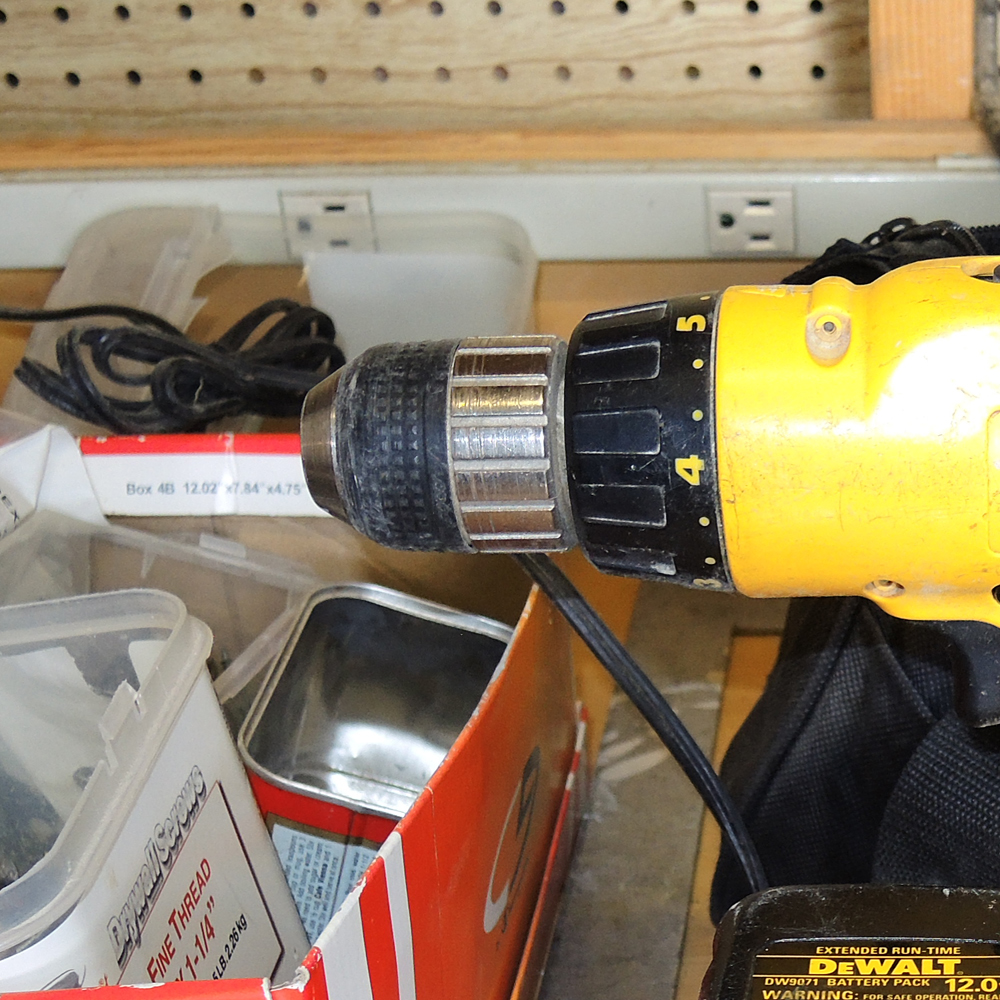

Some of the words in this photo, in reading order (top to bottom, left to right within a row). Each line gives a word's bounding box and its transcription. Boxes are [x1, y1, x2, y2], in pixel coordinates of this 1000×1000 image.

[676, 314, 707, 332] 5
[675, 455, 705, 486] 4
[126, 483, 152, 495] Box
[157, 483, 175, 495] 4B
[168, 858, 212, 941] THREAD
[816, 946, 887, 954] EXTENDED
[891, 946, 960, 954] RUN-TIME
[826, 978, 889, 986] BATTERY
[893, 978, 930, 986] PACK
[762, 990, 859, 1000] WARNING:
